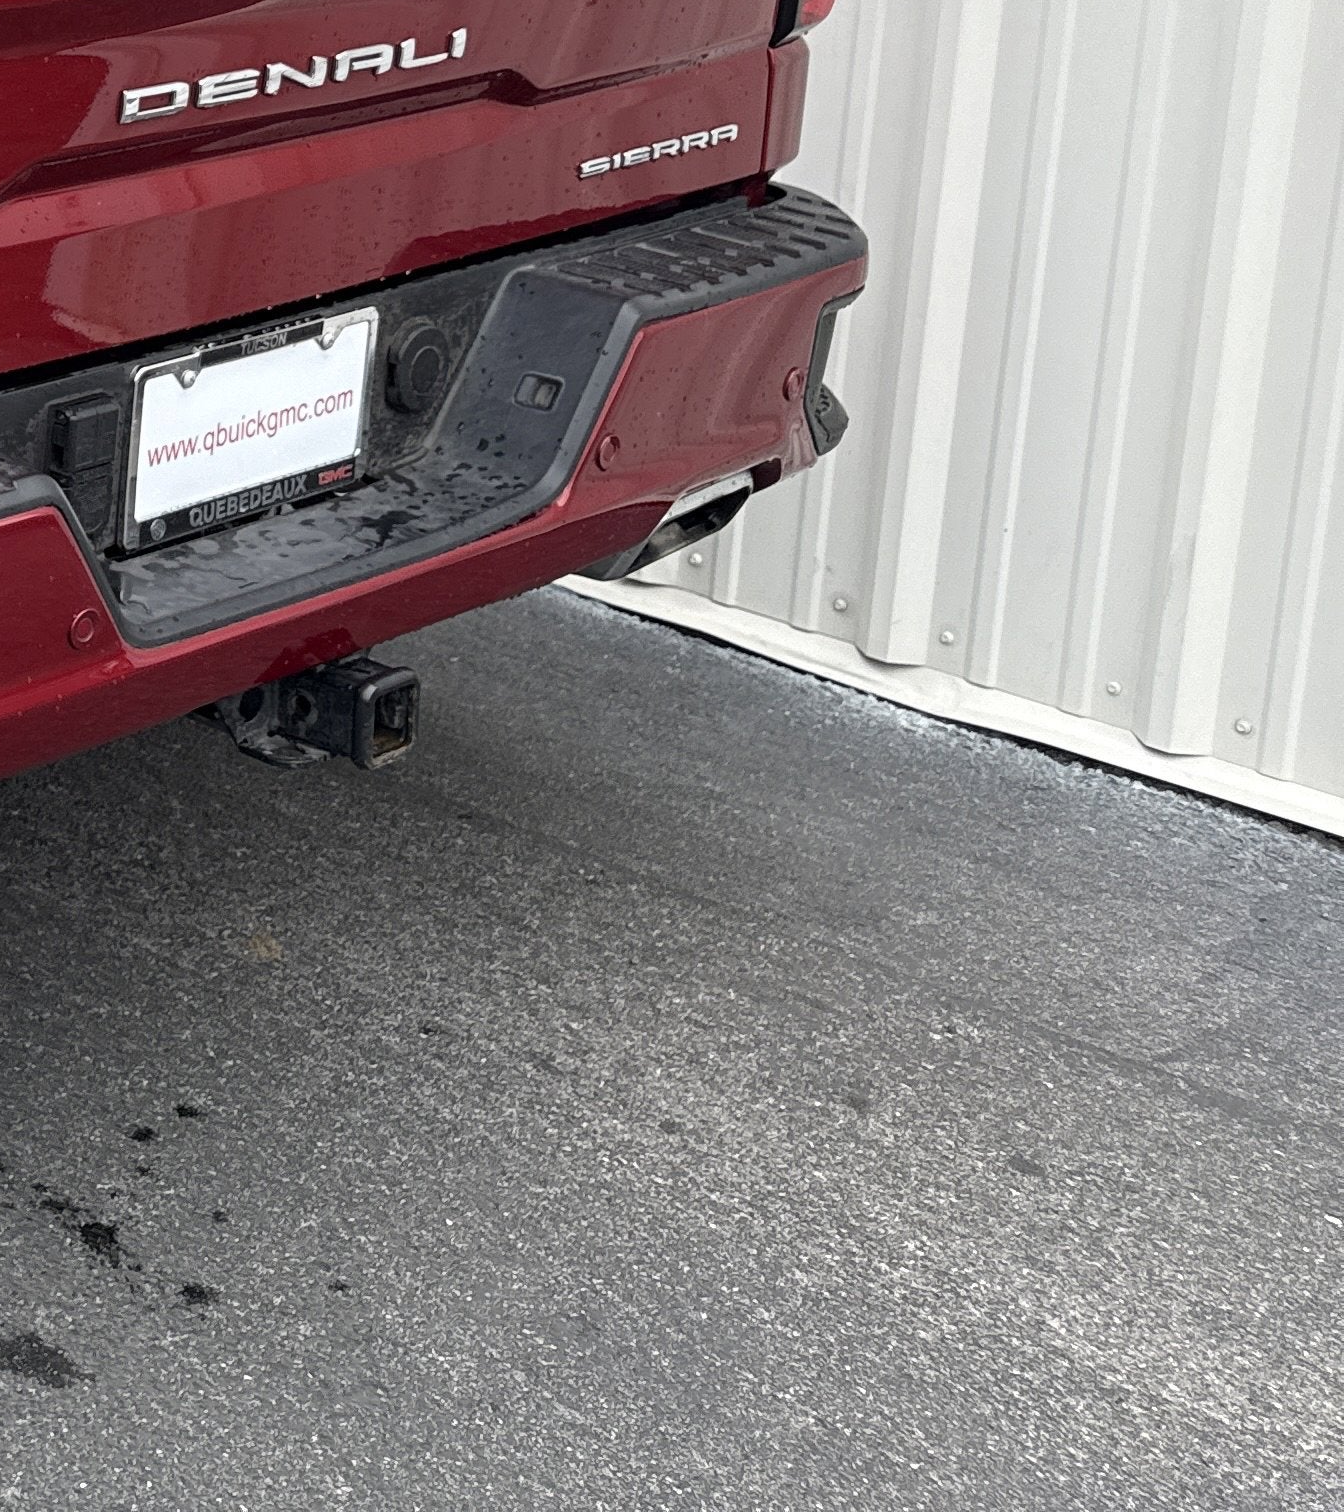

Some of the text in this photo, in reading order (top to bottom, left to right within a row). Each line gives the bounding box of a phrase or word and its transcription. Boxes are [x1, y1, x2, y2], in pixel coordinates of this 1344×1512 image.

[119, 28, 467, 124] DENALI
[579, 123, 739, 179] SIERRA
[240, 332, 288, 356] TUCSON
[147, 389, 354, 467] www.qbuickgmc.com
[188, 463, 353, 527] QUEBEDEAUX GMC
